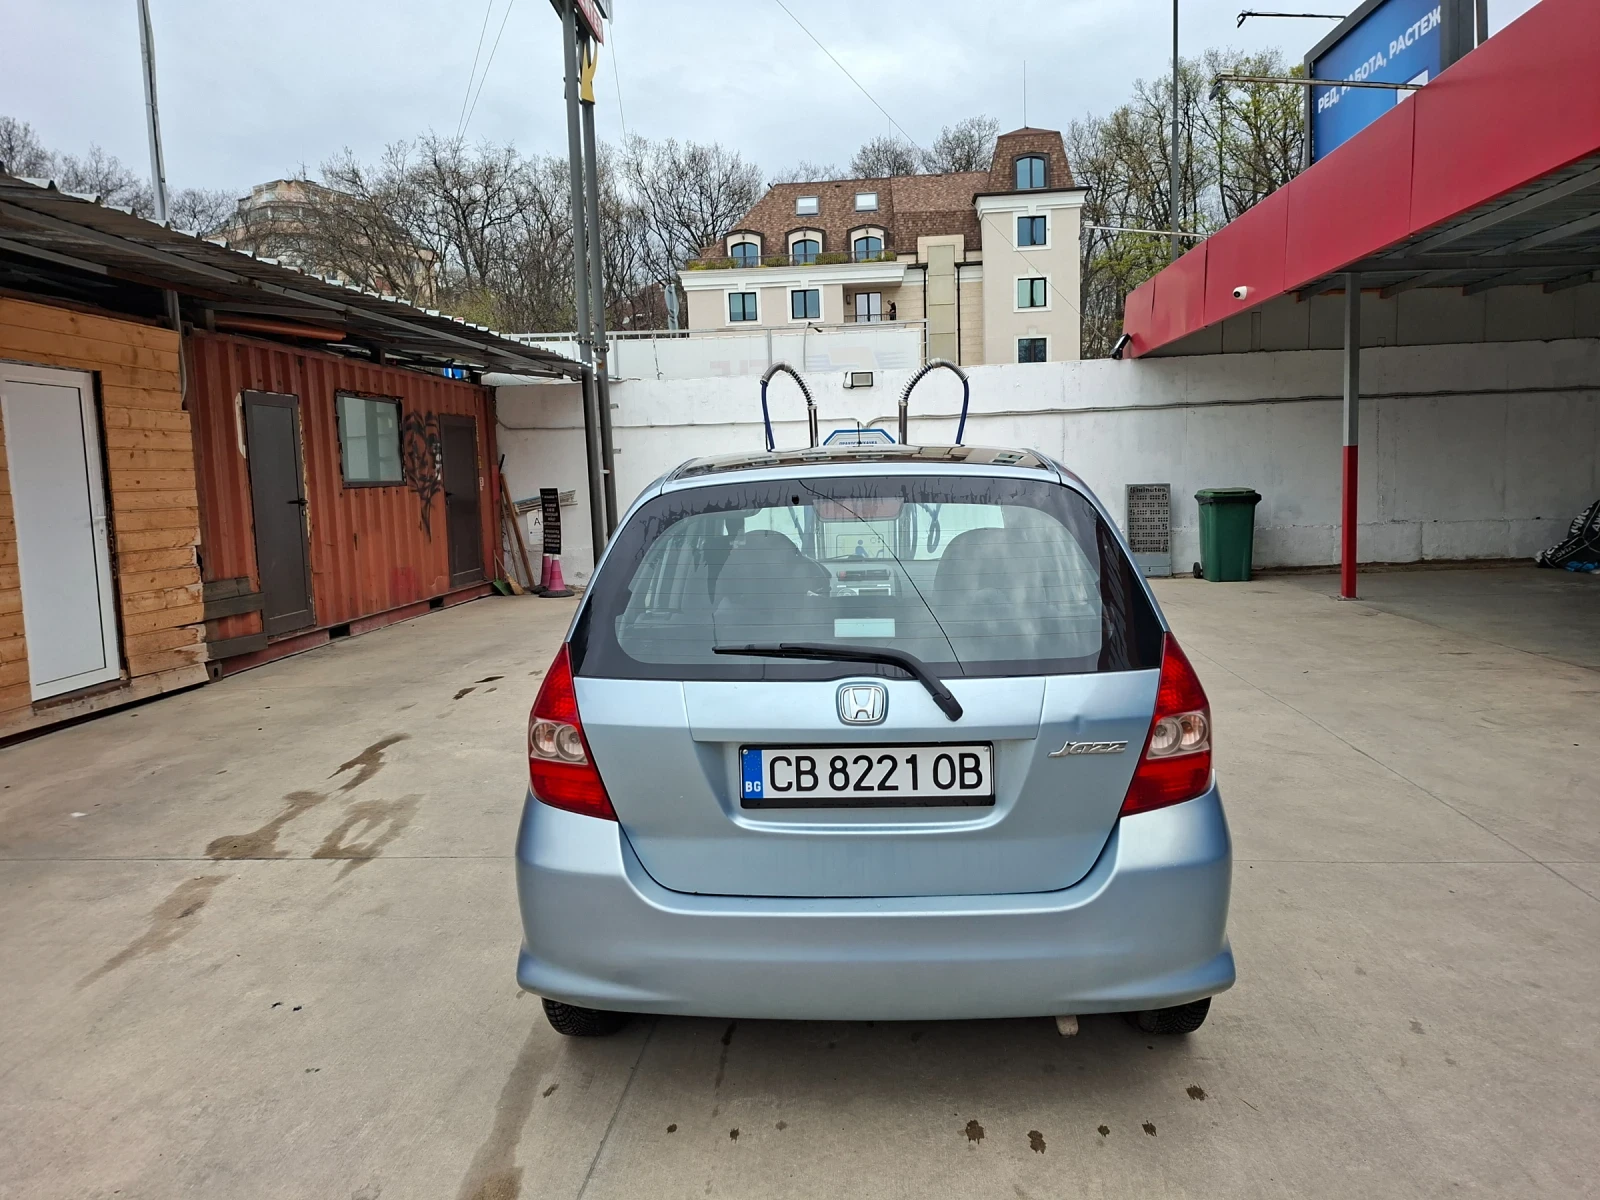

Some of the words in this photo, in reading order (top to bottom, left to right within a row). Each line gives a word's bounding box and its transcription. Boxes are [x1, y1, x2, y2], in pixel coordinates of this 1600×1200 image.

[1341, 51, 1387, 95] РАБОТА,
[1389, 5, 1441, 59] РАСТЕЖ
[745, 781, 761, 793] BG
[769, 755, 819, 792] CB
[828, 754, 919, 792] 8221
